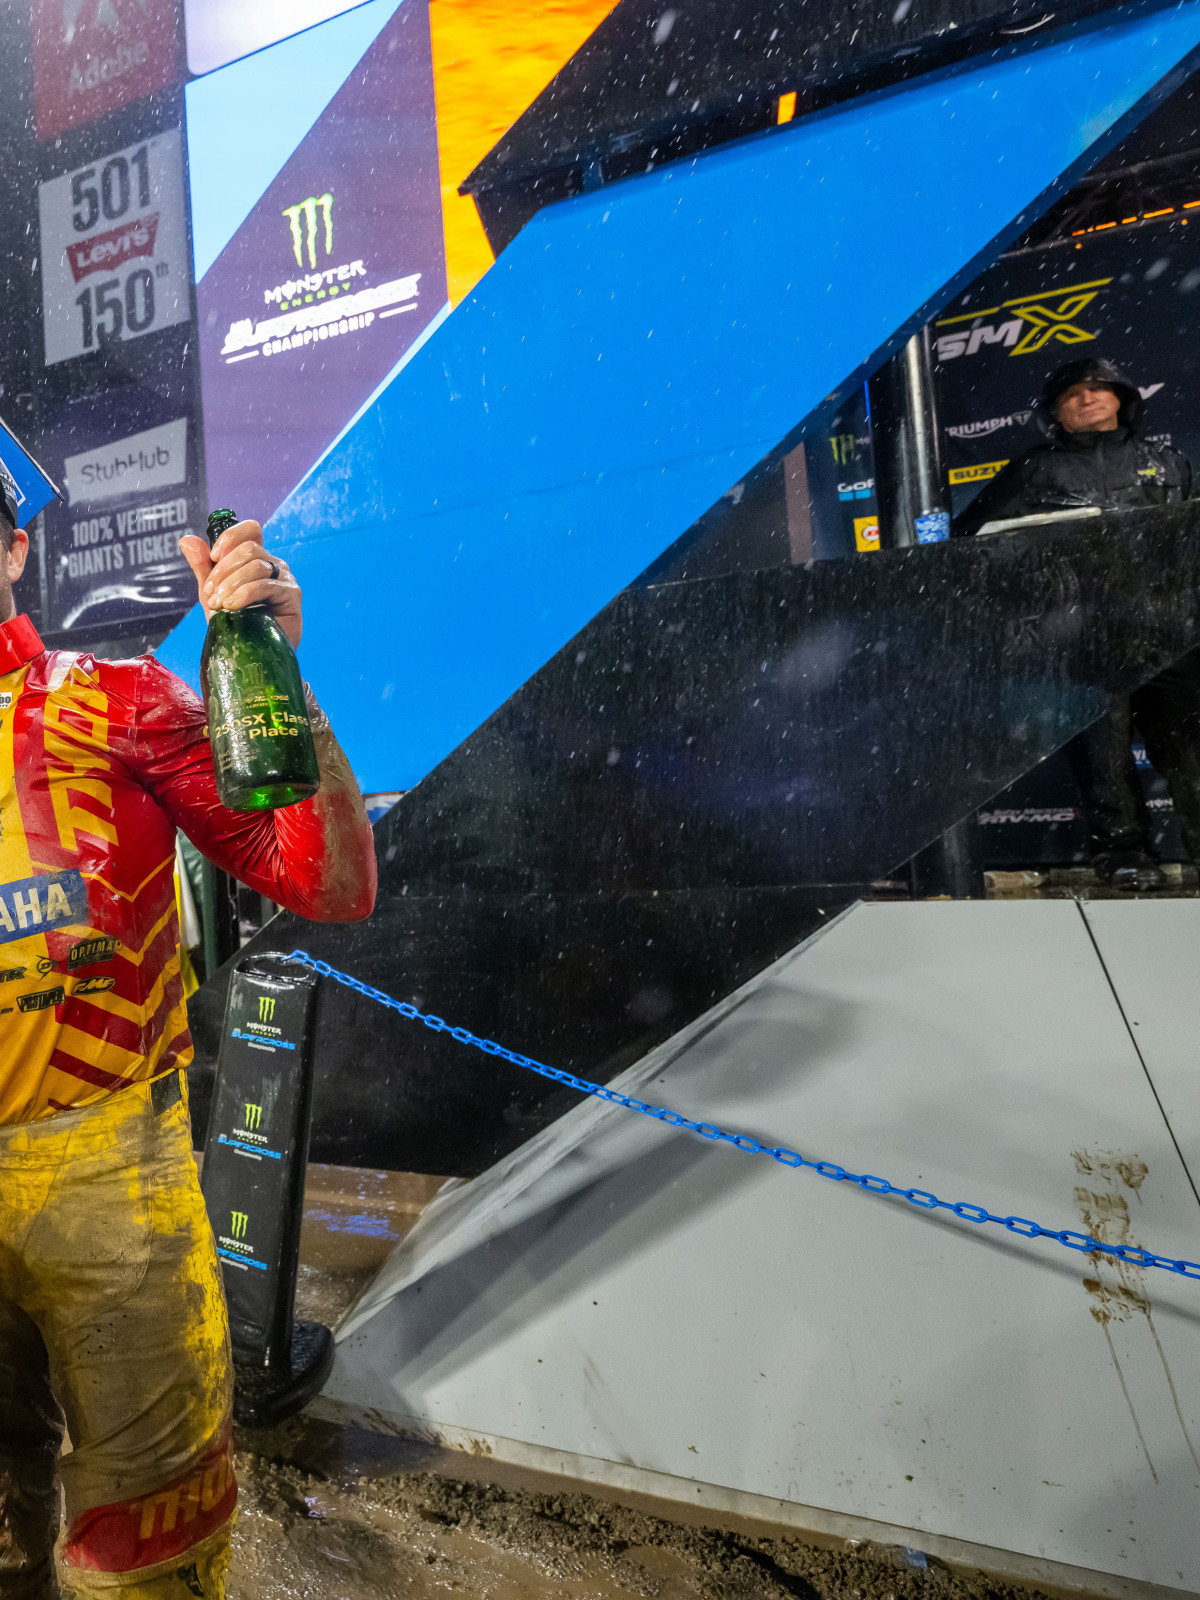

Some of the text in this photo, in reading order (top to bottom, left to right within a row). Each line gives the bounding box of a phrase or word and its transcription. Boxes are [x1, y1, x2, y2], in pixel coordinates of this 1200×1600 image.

[68, 41, 150, 97] Adobe
[72, 146, 150, 232] 501
[264, 260, 366, 304] MONSTER
[263, 312, 375, 356] CHAMPIONSHIP
[937, 291, 1098, 362] SMX
[81, 446, 170, 484] StubHub
[72, 498, 188, 547] 100% VERIFIED
[68, 528, 194, 578] GIANTS TICKET
[250, 726, 299, 740] Place
[271, 711, 309, 726] Class
[246, 1022, 282, 1035] MONSTER
[232, 1128, 268, 1144] MONSTER
[217, 1247, 268, 1270] PERCROSS
[219, 1236, 254, 1253] MONSTER
